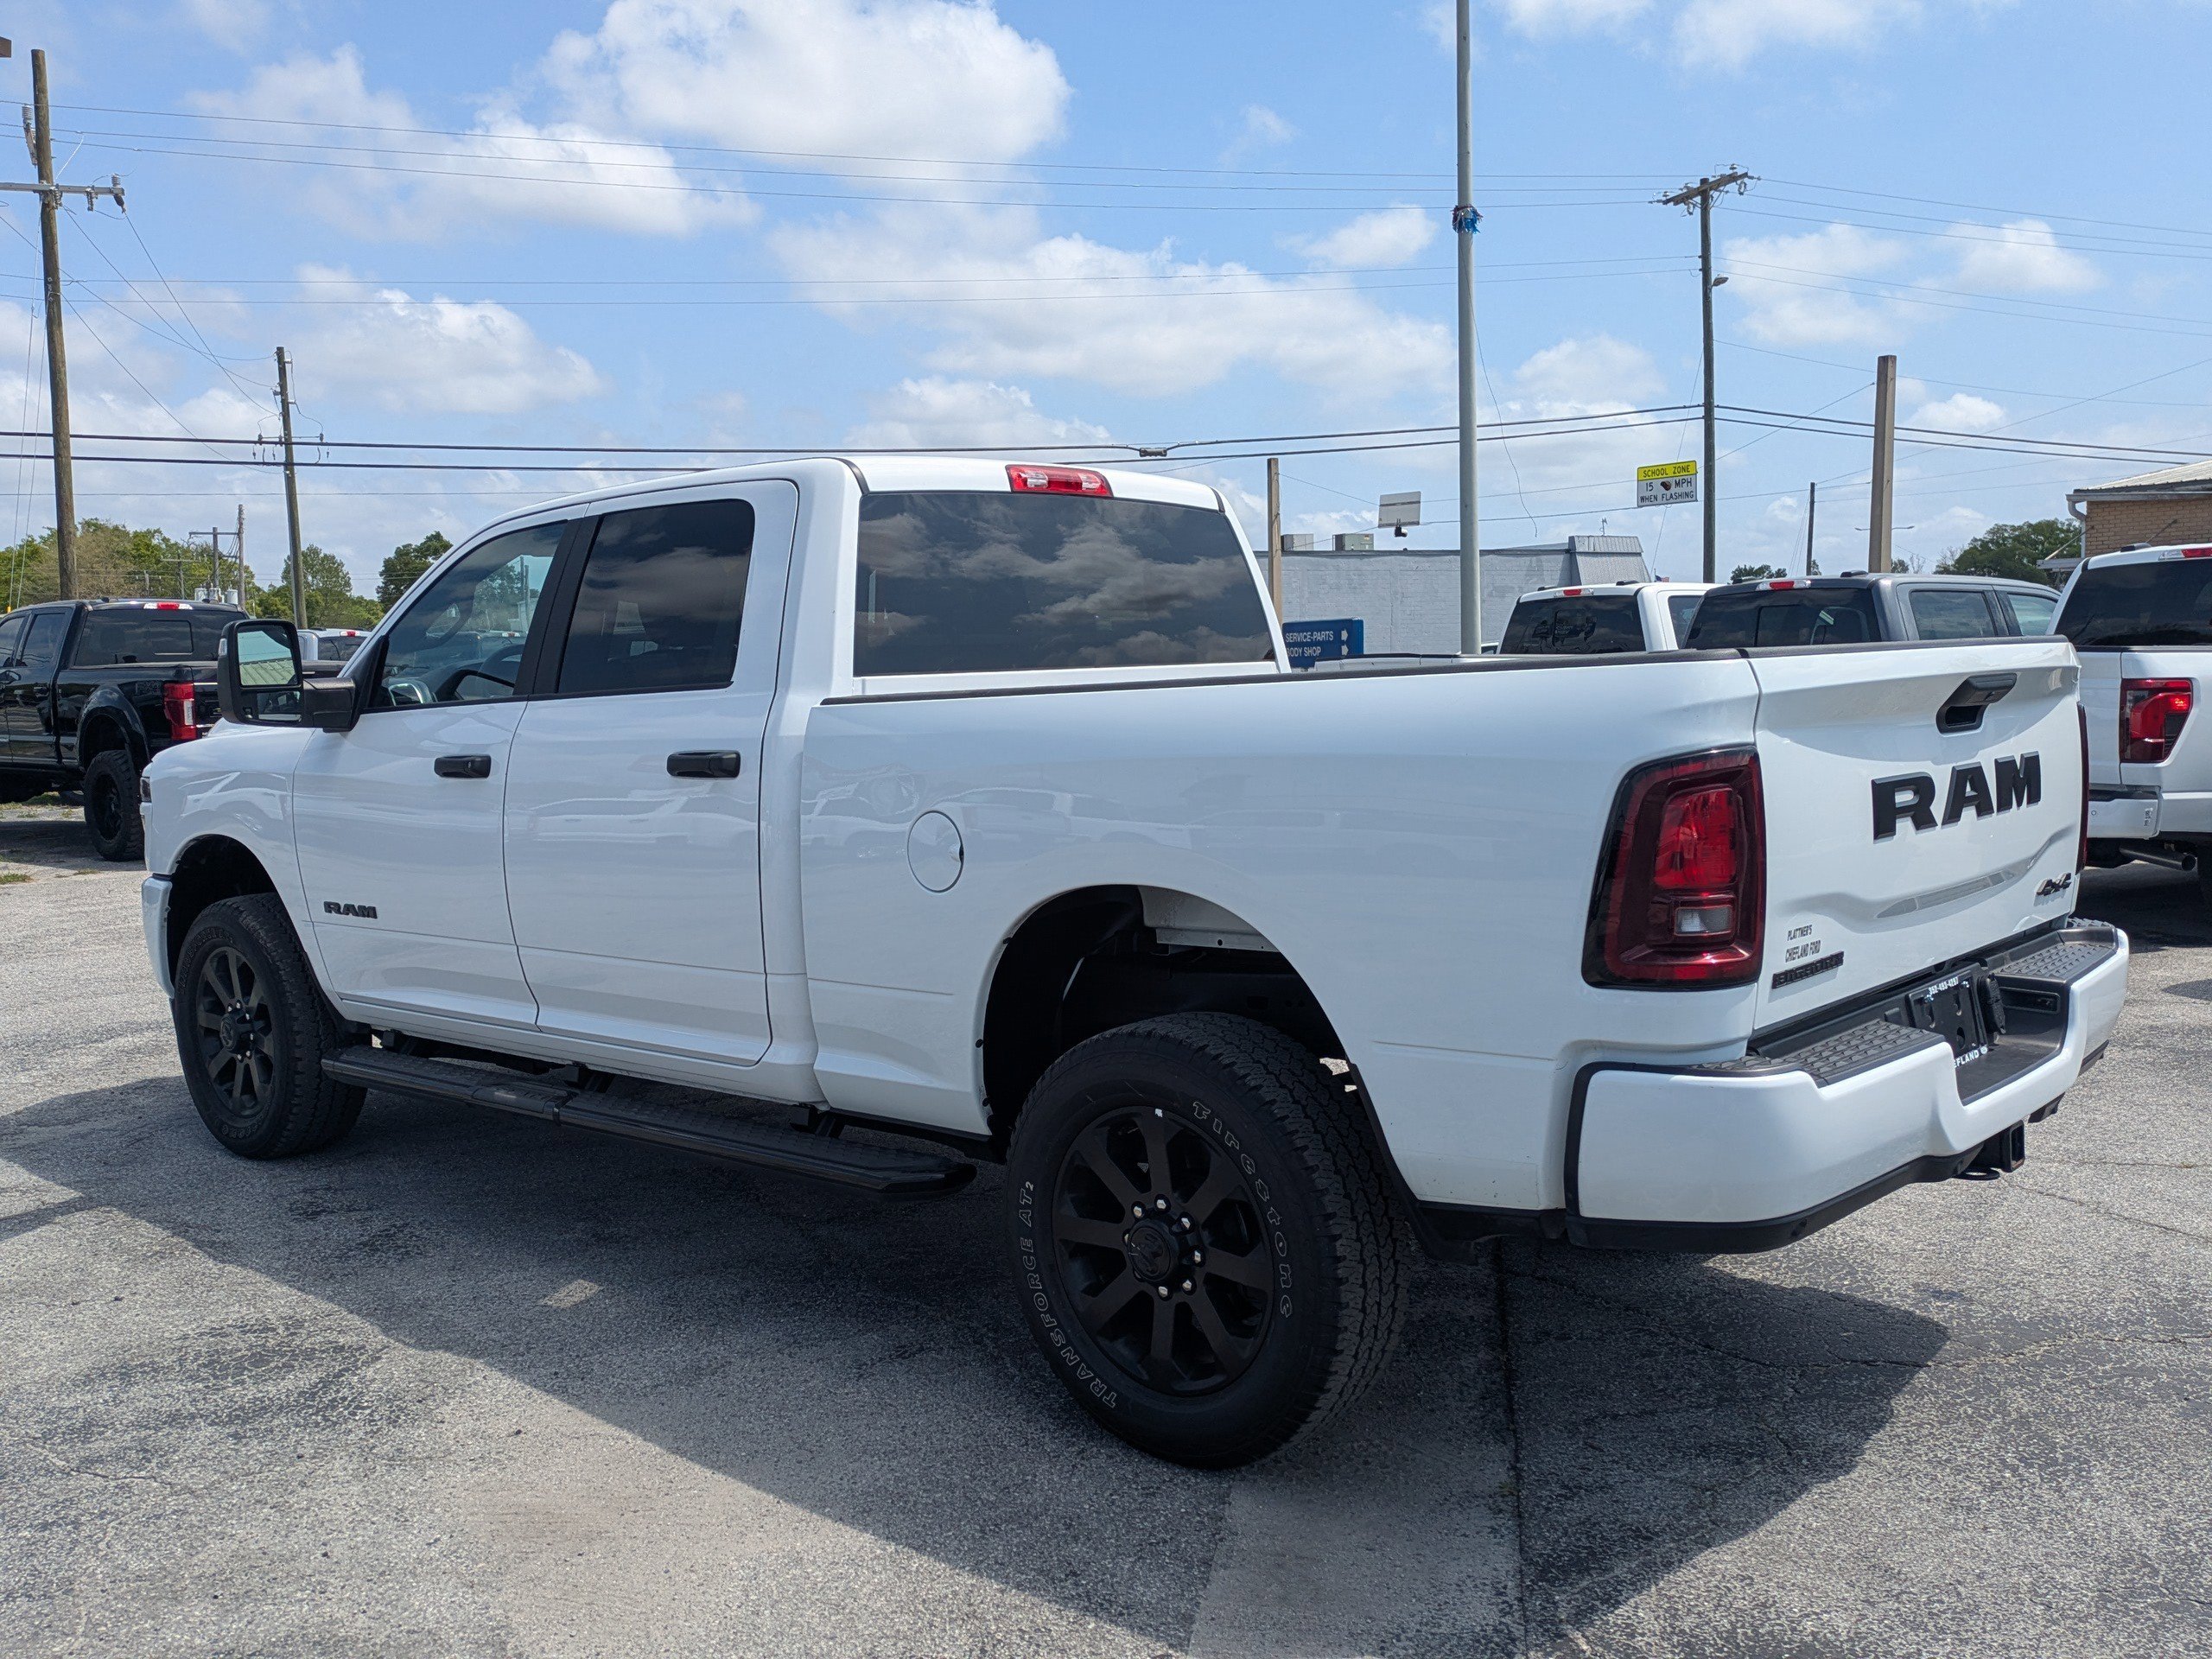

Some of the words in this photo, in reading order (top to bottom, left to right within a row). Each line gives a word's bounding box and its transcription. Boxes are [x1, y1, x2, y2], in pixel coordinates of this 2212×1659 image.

[1643, 468, 1668, 478] SCHOOL
[1673, 464, 1690, 474] ZONE
[1645, 482, 1653, 492] 15
[1675, 477, 1692, 488] MPH
[1640, 494, 1657, 503] WHEN
[1661, 490, 1694, 501] FLASHING
[1285, 631, 1333, 642] SERVICE-PARTS
[1303, 646, 1321, 656] SHOP
[1871, 750, 2042, 841] RAM
[323, 900, 378, 919] RAM
[1020, 1236, 1119, 1410] TRANSFORCE
